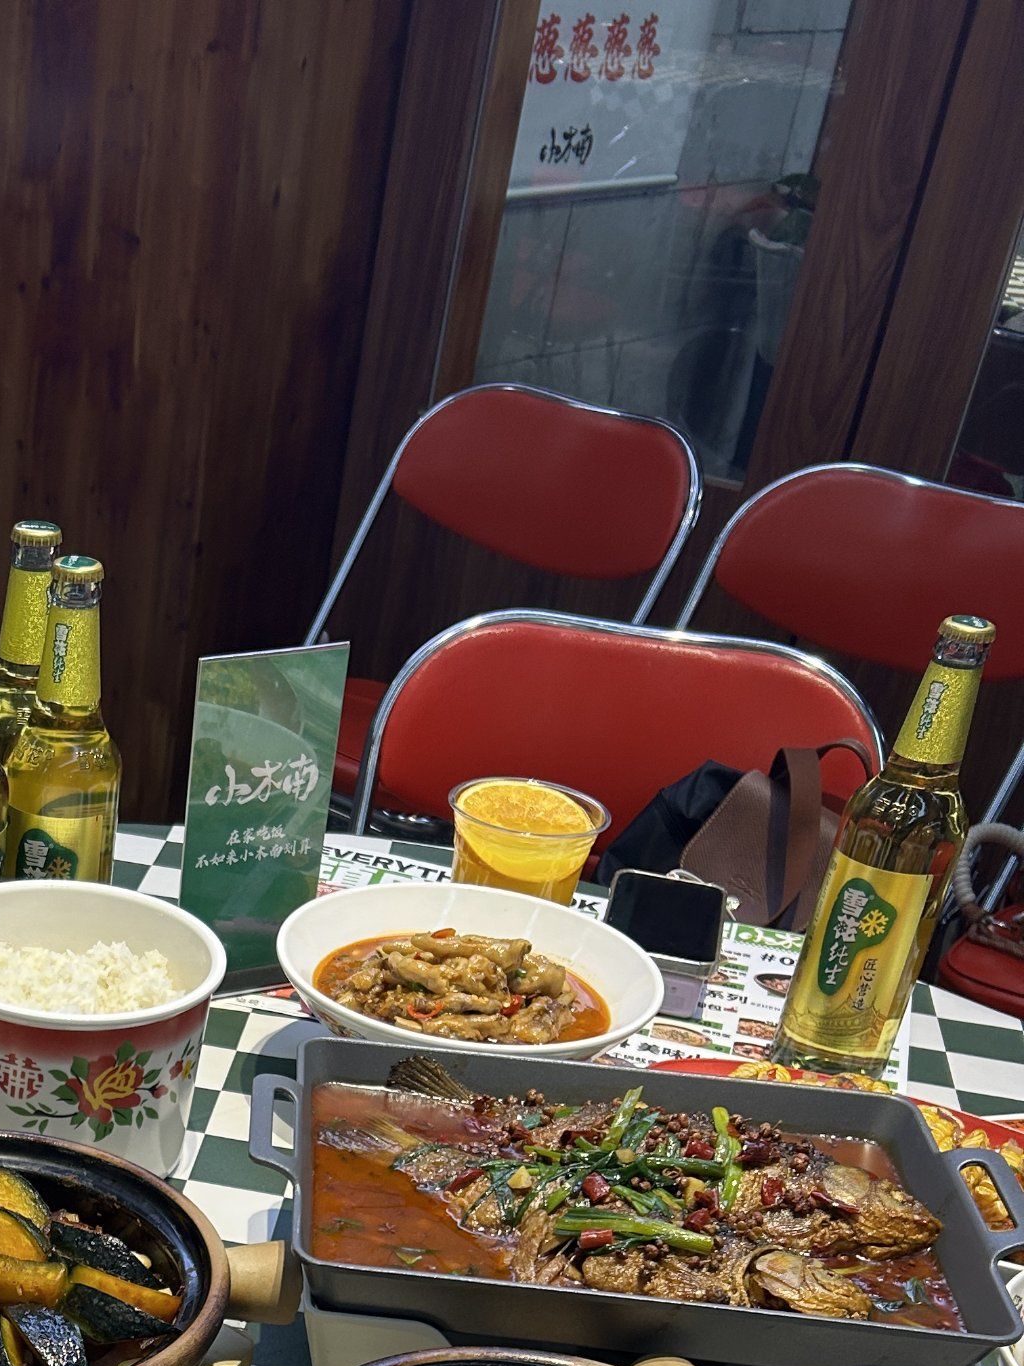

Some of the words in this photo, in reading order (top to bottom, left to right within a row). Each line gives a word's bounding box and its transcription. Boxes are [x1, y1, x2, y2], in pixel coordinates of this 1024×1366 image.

[917, 681, 947, 741] 雪花纯生
[226, 825, 287, 846] 在家吃饭
[823, 888, 870, 987] 雪花纯生
[852, 957, 878, 1012] 匠心营造
